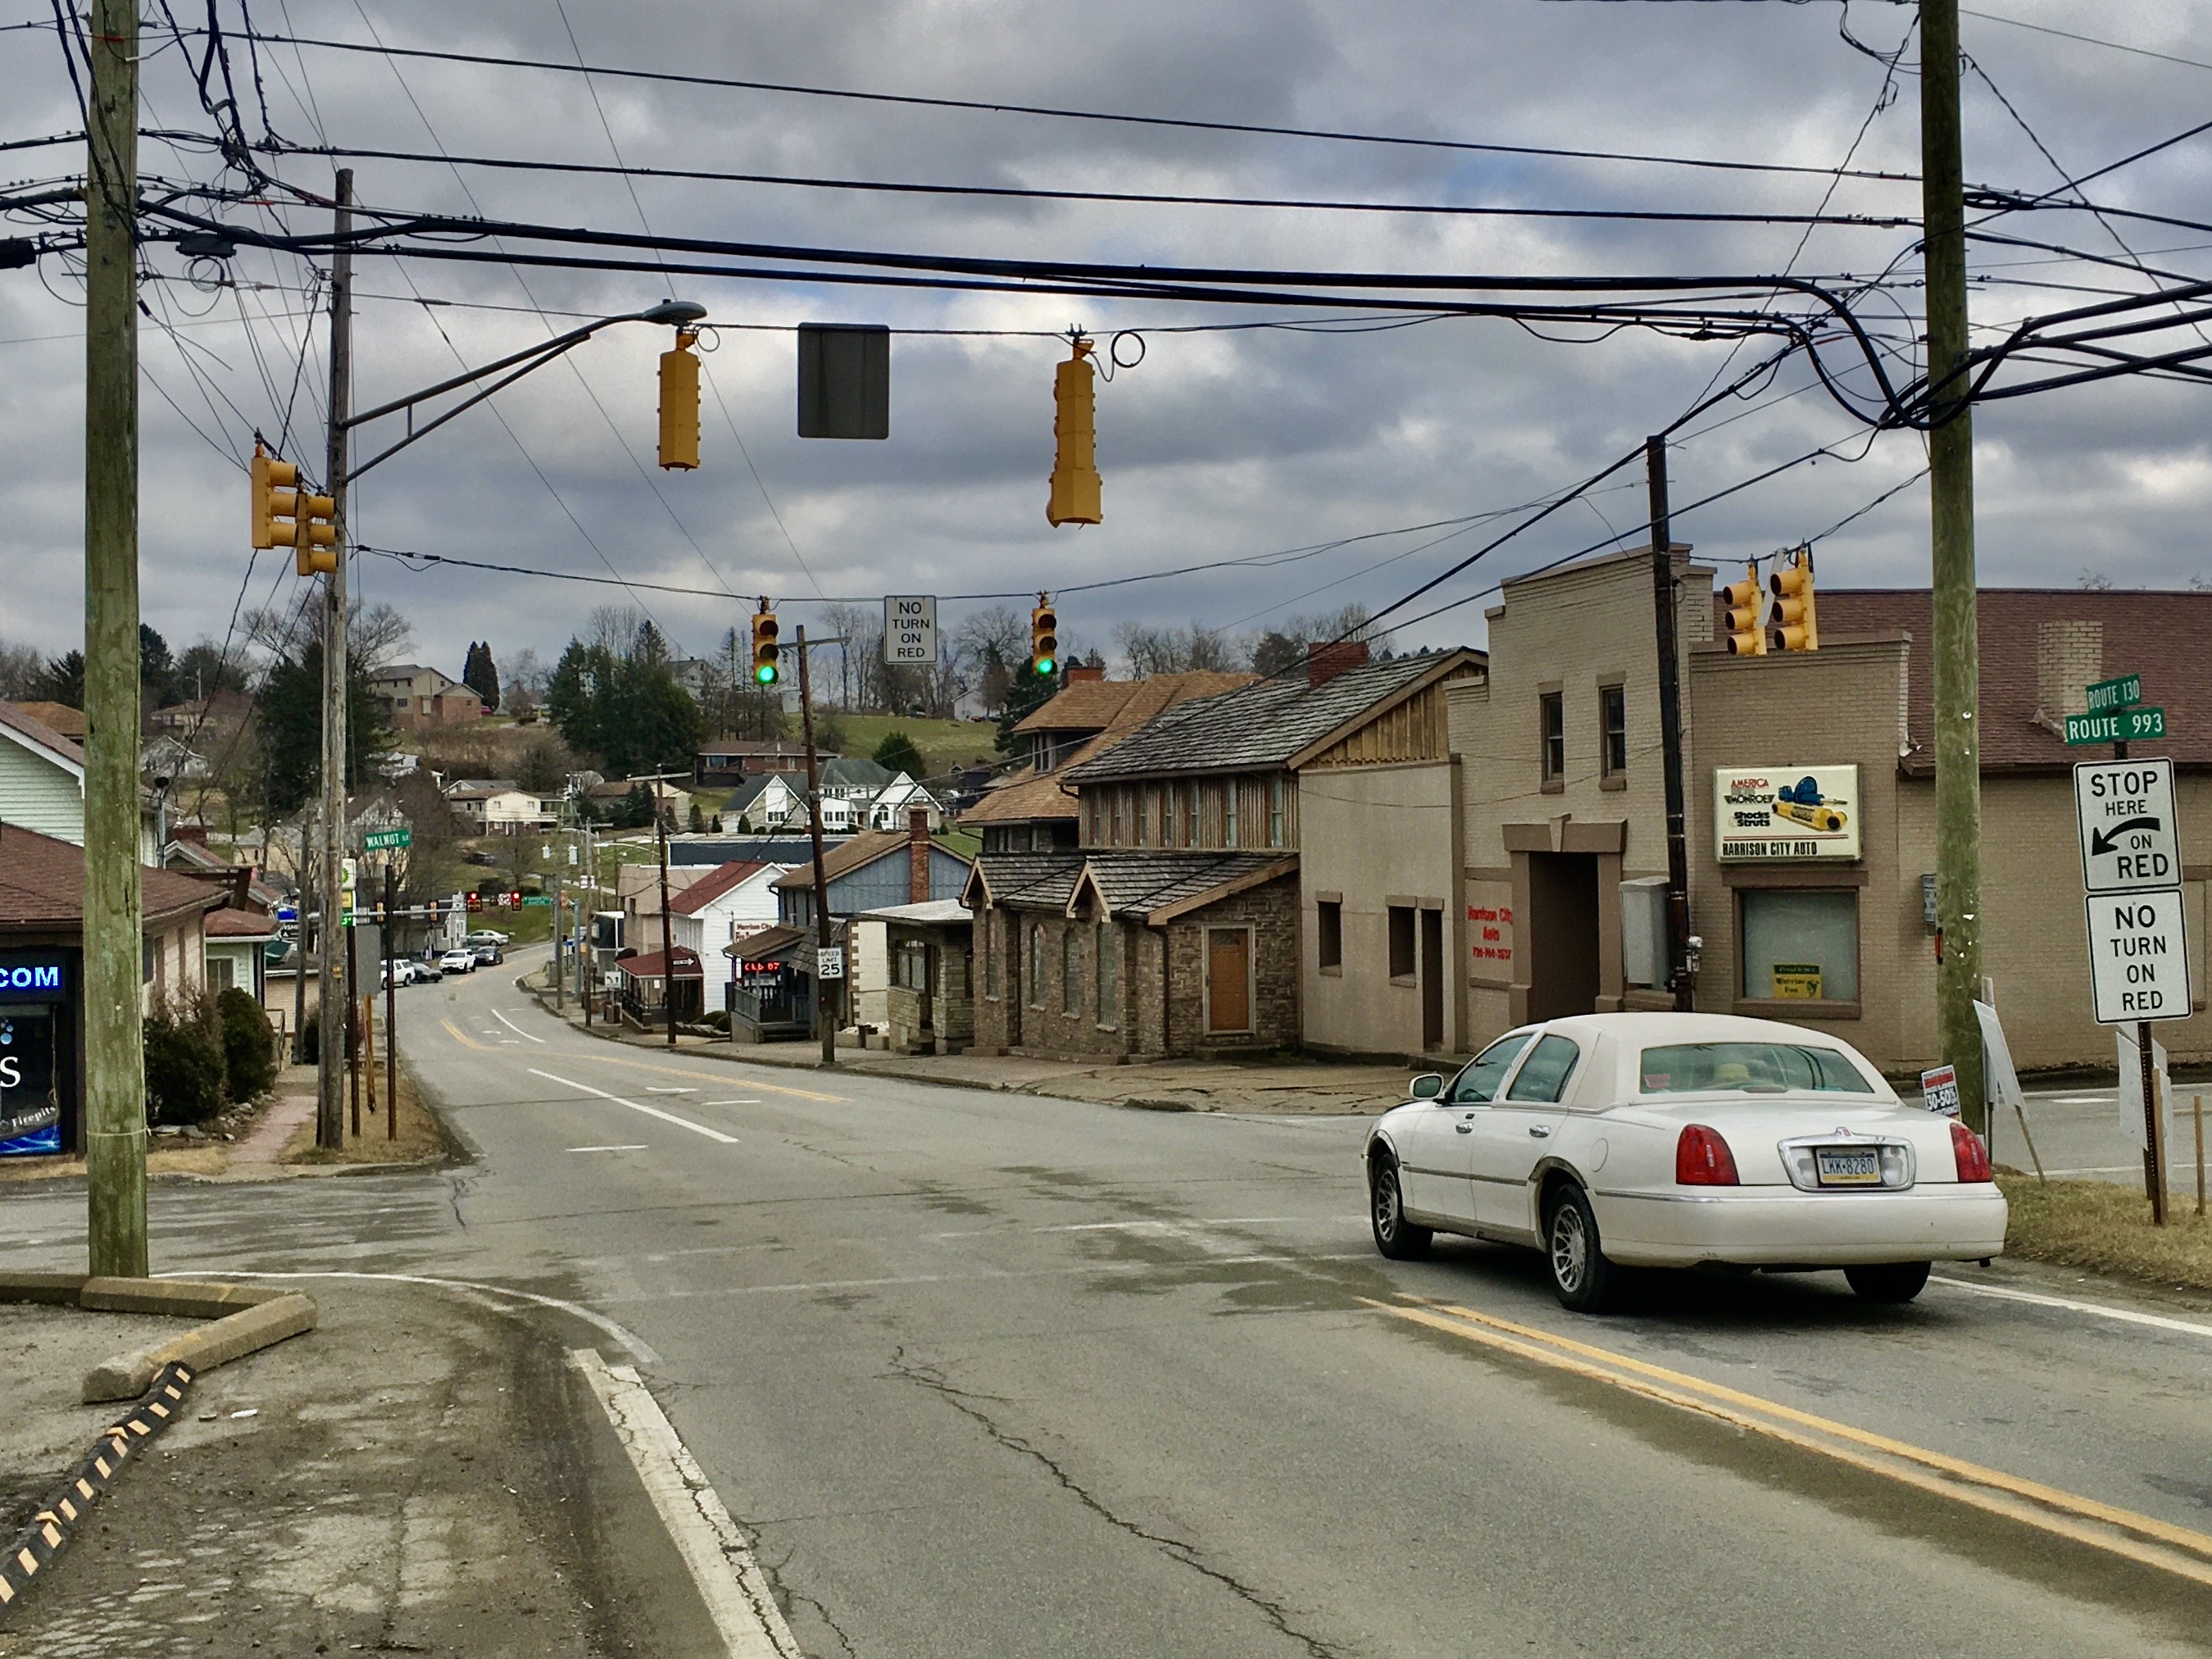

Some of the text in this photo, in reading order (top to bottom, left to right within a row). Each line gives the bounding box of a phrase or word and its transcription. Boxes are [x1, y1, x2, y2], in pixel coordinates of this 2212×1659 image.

[899, 602, 922, 615] NO
[892, 619, 930, 630] TURN
[901, 633, 921, 643] ON
[897, 648, 925, 658] RED
[2088, 680, 2140, 710] ROUTE 130
[2069, 713, 2164, 740] ROUTE 993
[1730, 779, 1770, 789] AMERICA
[2091, 770, 2159, 798] STOP
[1731, 794, 1769, 804] MONROE
[2105, 799, 2148, 816] HERE
[1734, 811, 1771, 820] Shocks
[1737, 819, 1771, 827] Struts
[366, 833, 399, 848] WALNUT
[2130, 834, 2153, 850] ON
[1723, 841, 1818, 856] HARRISON CITY AUTO
[2116, 853, 2169, 879] RED
[2114, 904, 2156, 930] NO
[2110, 935, 2167, 957] TURN
[820, 963, 840, 976] 25
[2126, 963, 2155, 984] ON
[2122, 990, 2164, 1011] RED
